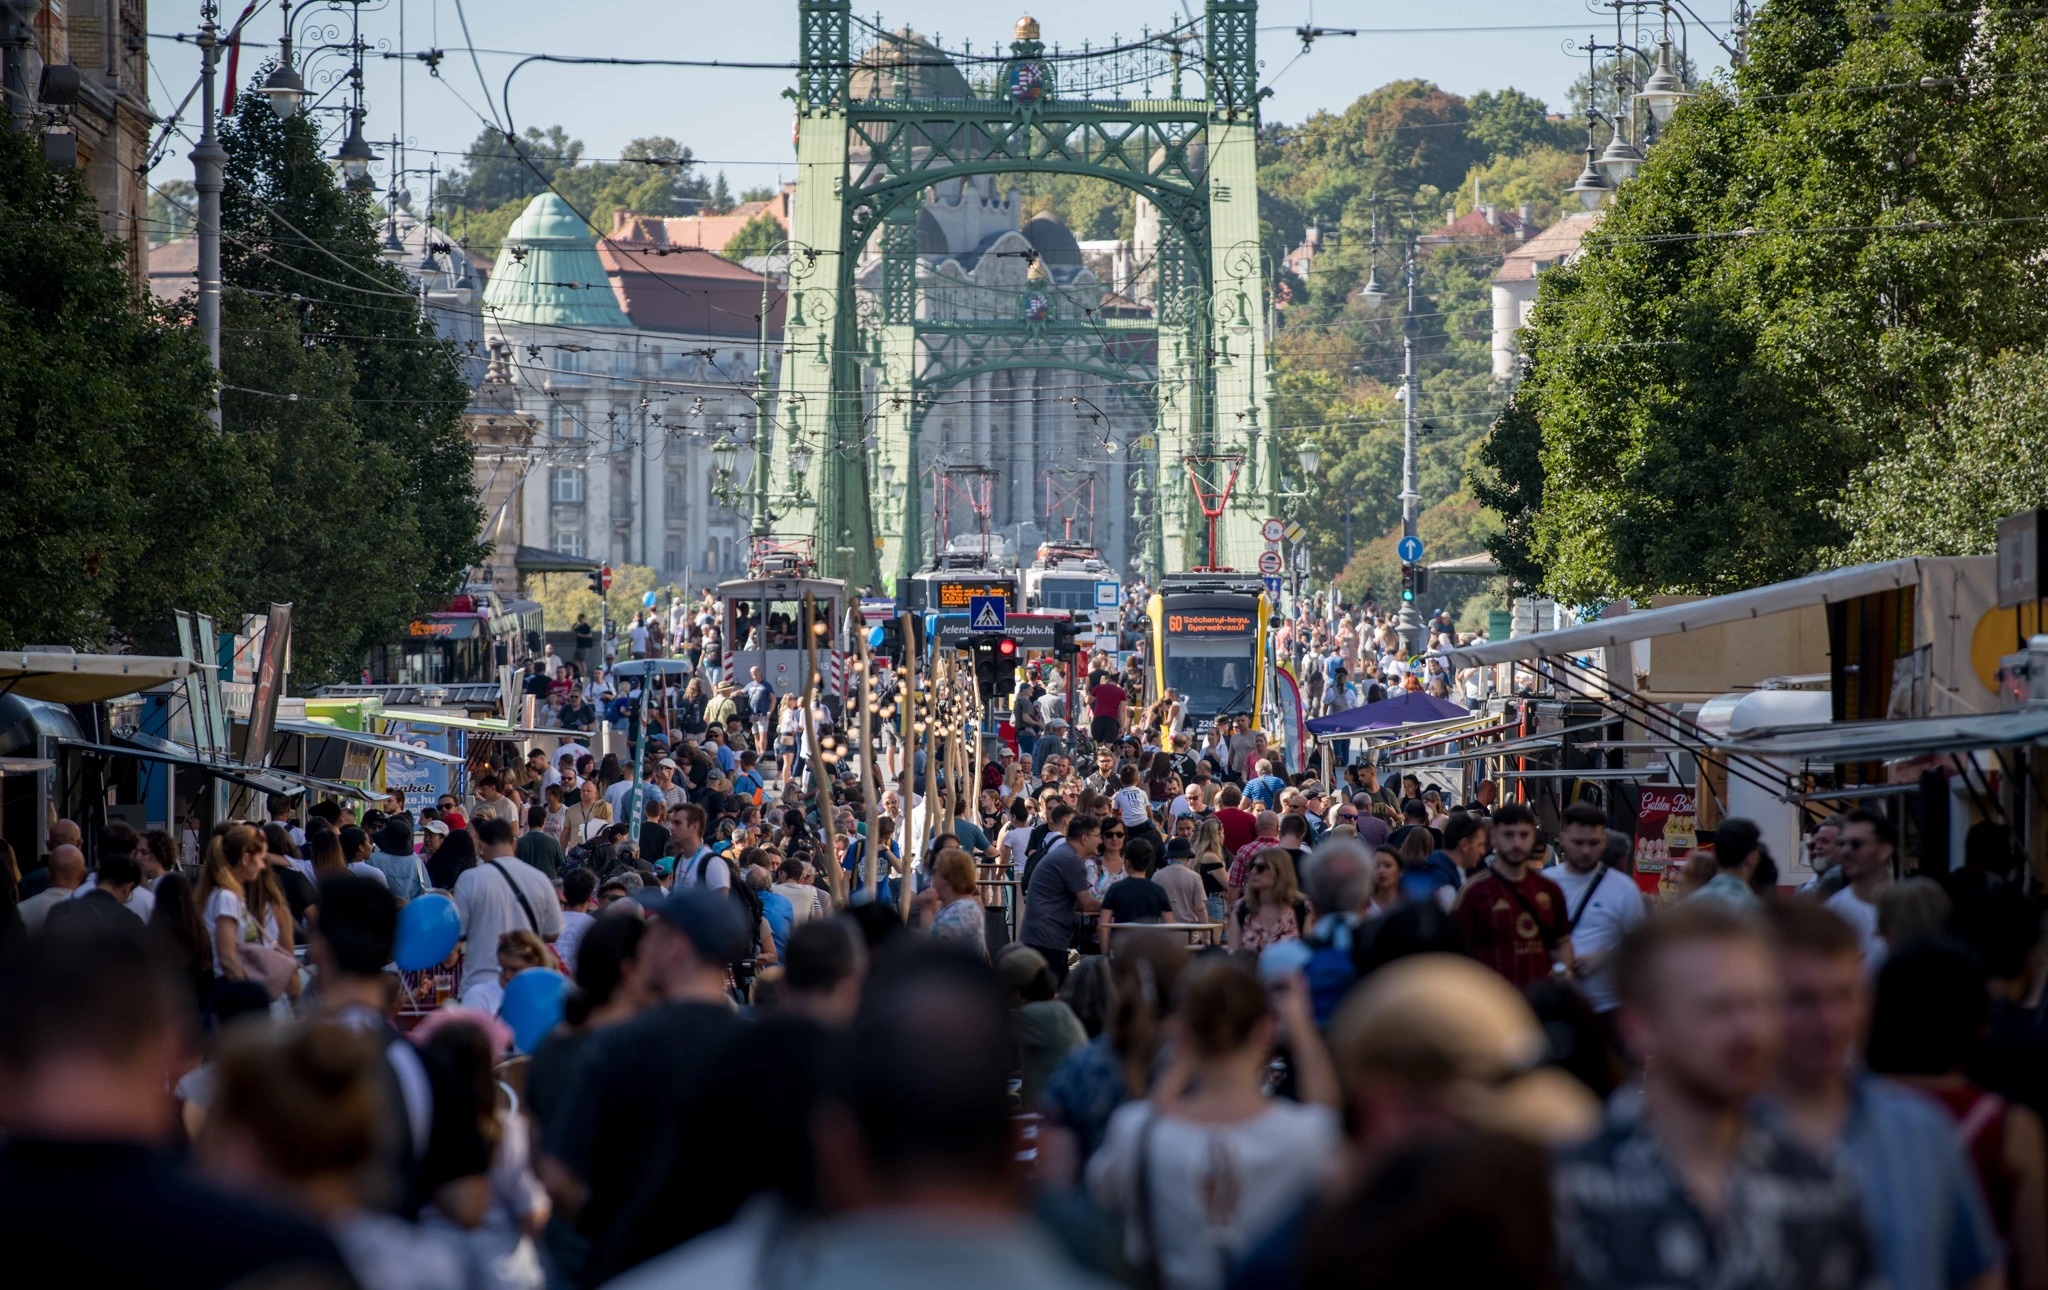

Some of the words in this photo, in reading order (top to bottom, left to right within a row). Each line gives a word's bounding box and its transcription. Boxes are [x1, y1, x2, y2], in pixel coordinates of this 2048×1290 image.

[1169, 615, 1182, 632] 60
[1183, 616, 1250, 625] Széchenyi-hegy,
[1187, 623, 1245, 631] Gyermekvasút
[1639, 792, 1670, 817] Golden
